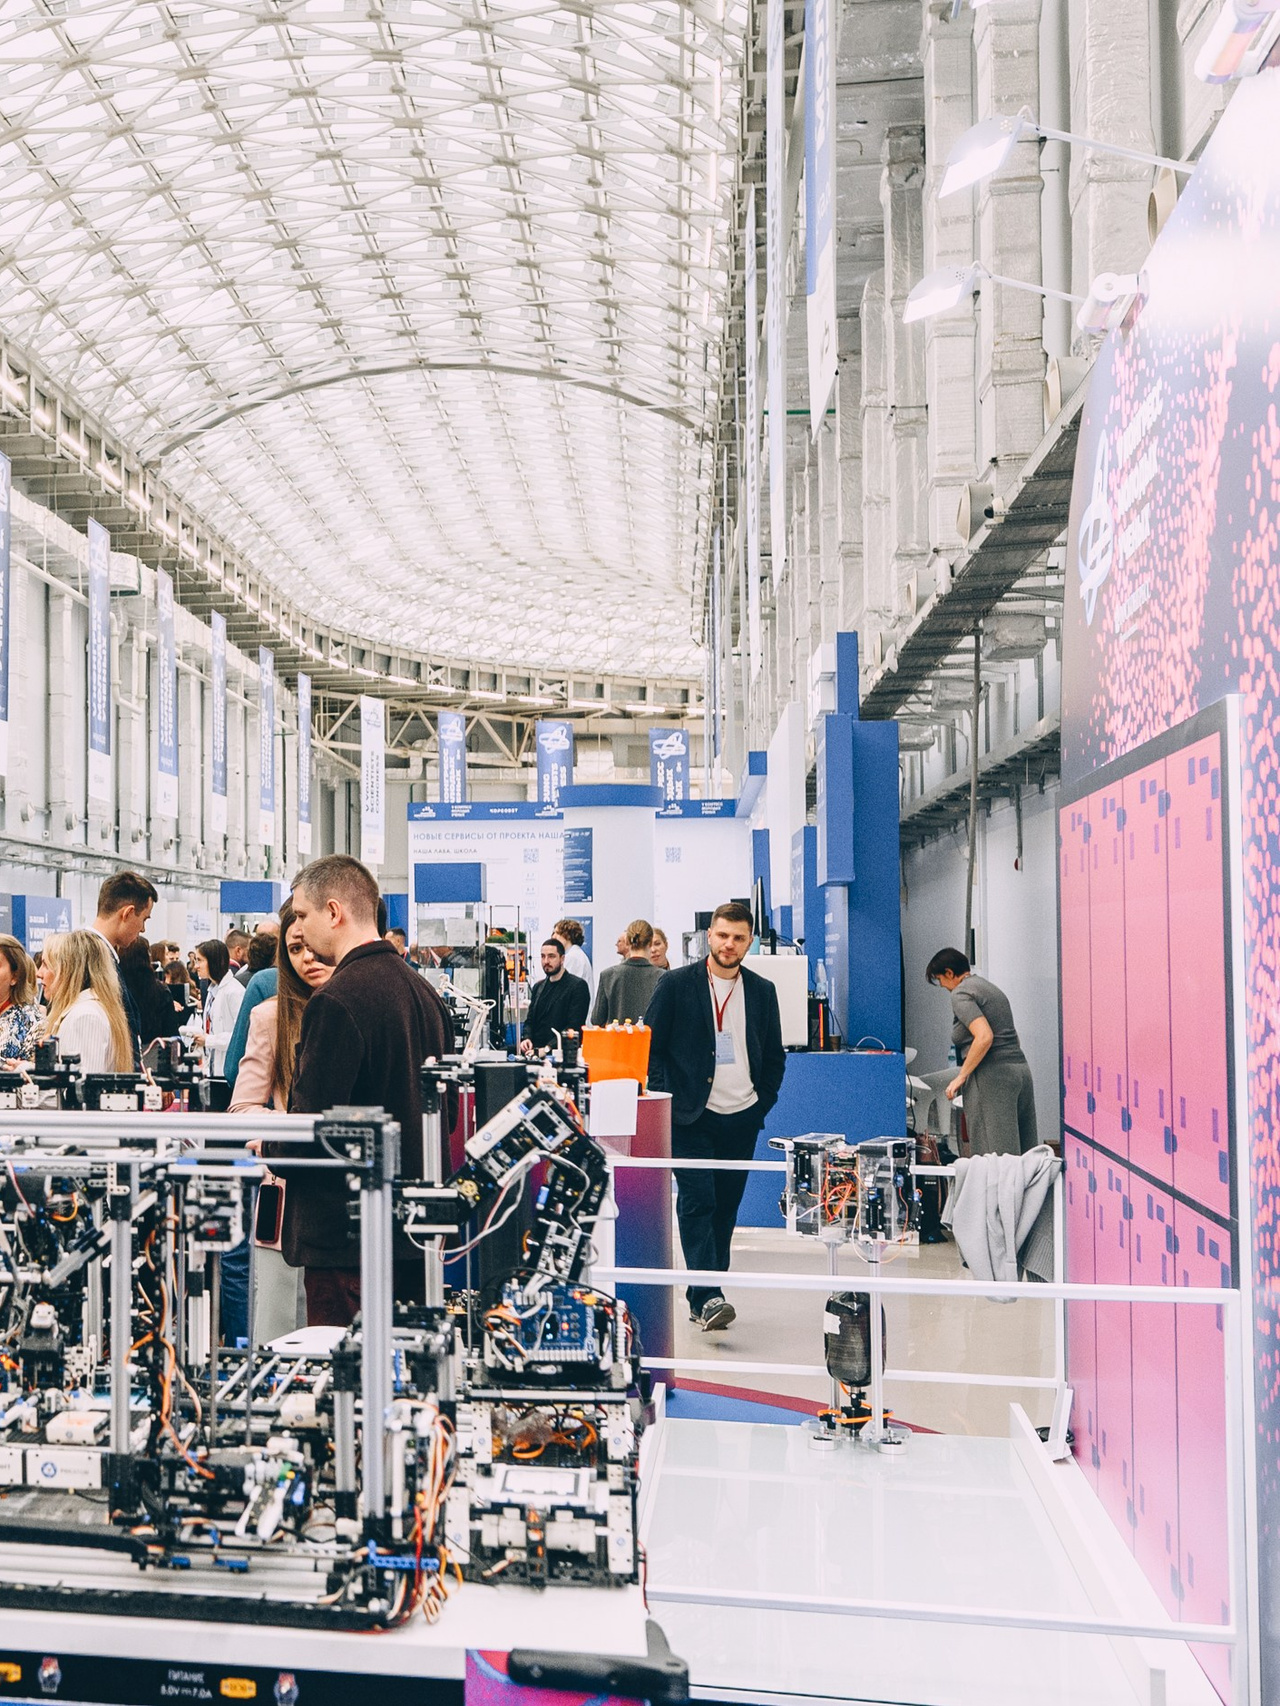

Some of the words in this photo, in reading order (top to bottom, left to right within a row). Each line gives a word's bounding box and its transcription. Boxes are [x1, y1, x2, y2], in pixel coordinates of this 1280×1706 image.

[413, 832, 441, 840] НОВЫЕ
[445, 832, 483, 840] СЕРВИСЫ
[486, 832, 497, 840] ОТ
